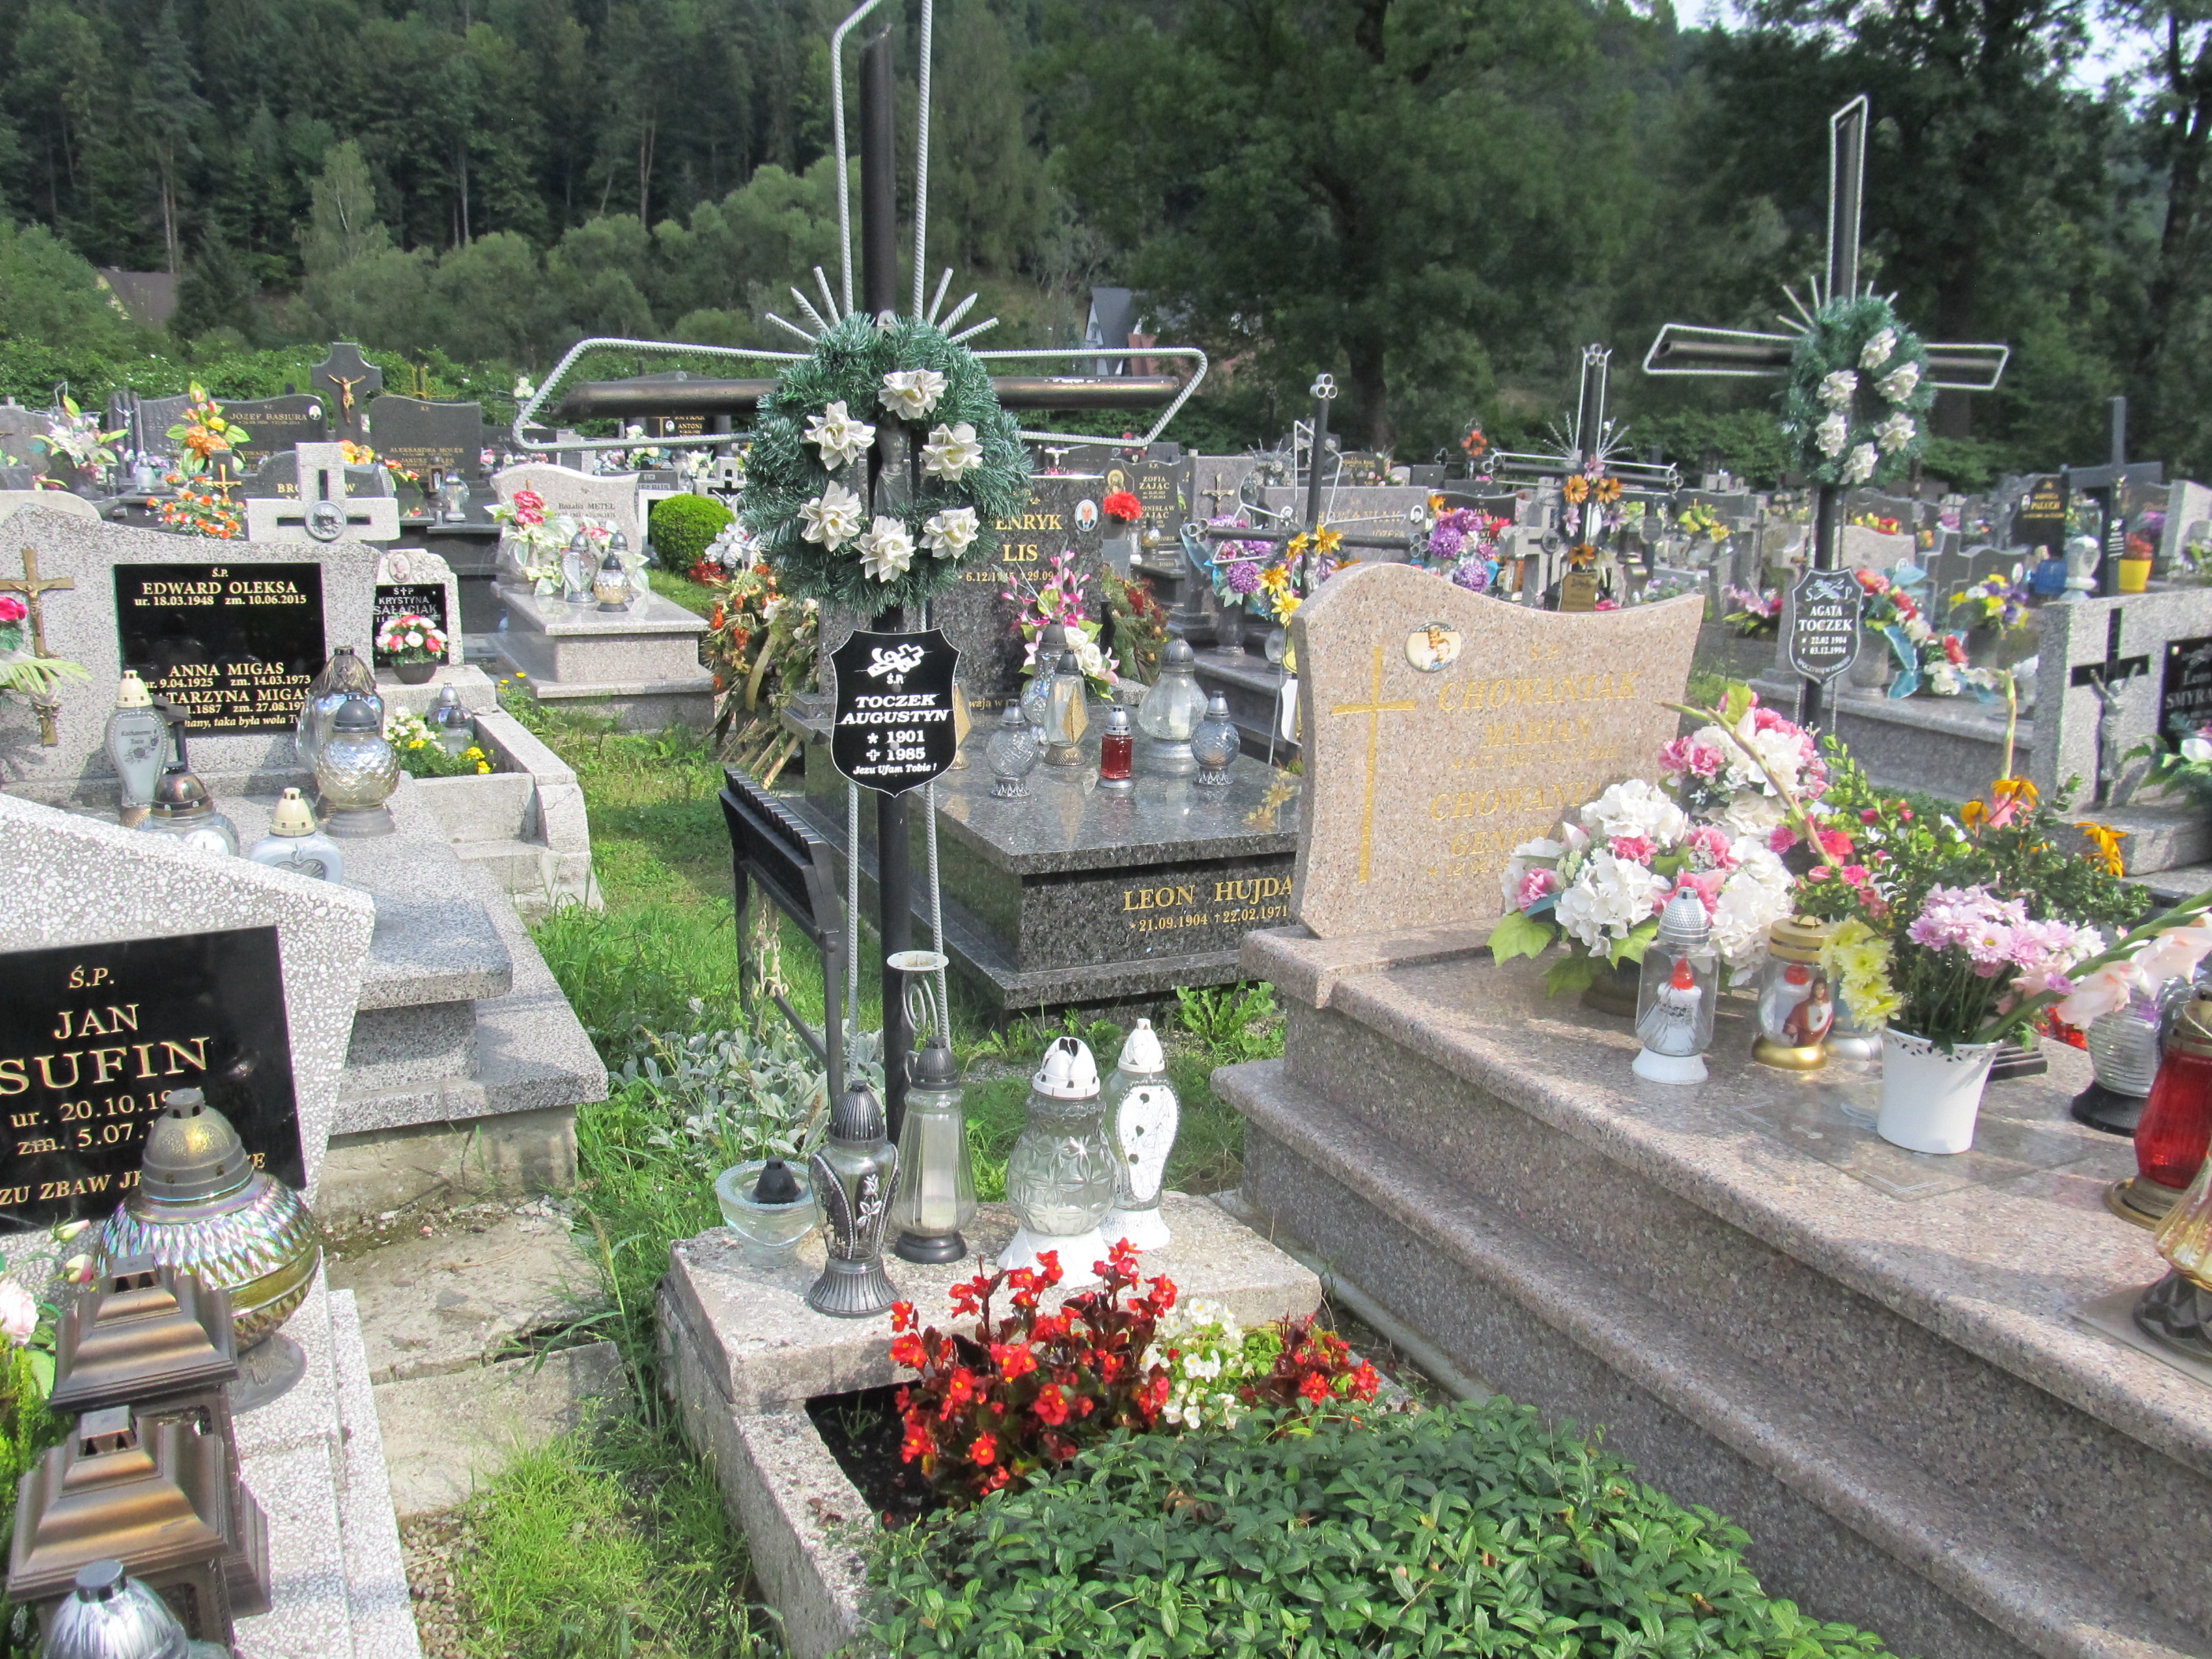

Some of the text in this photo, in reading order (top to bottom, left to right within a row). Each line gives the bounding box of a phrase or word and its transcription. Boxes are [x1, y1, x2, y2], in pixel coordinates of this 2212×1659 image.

[994, 514, 1063, 530] ENRYK
[1002, 544, 1038, 562] LIS
[142, 581, 298, 595] EDWARD OLEKSA
[134, 595, 307, 606] ur. 18.03.1948 zm. 10.06.2015
[379, 596, 430, 605] KRYSTYNA
[1810, 605, 1843, 616] AGATA
[1798, 619, 1853, 632] TOCZEK
[168, 662, 285, 677] ANNA MIGAS
[159, 678, 214, 688] 9.04.1925
[230, 677, 251, 687] zm.
[254, 676, 311, 686] 14.03.1973
[166, 691, 251, 704] TARZYNA
[1438, 672, 1640, 710] CHOWANIAK
[187, 705, 222, 714] 1.1887
[258, 701, 306, 712] 27.08.197
[855, 694, 939, 709] TOCZEK
[238, 716, 260, 726] była
[262, 715, 286, 724] wola
[840, 710, 949, 724] AUGUSTYN
[887, 731, 925, 743] 1901
[1481, 716, 1592, 748] MARIAN
[887, 748, 925, 760] 1985
[853, 766, 875, 775] Jezu
[877, 764, 903, 775] Ufam
[906, 763, 930, 773] Tobie
[1430, 780, 1599, 819] CHOWANI
[1452, 824, 1553, 857] GENOW
[1123, 876, 1293, 910] LEON HUJDA
[1139, 906, 1288, 931] 21.09.1904 22.02.1971
[68, 966, 115, 989] Ś.P.
[53, 1004, 140, 1040] JAN
[0, 1037, 210, 1095] SUFIN
[10, 1090, 172, 1128] ur. 20.10.19
[17, 1138, 66, 1155] zm.
[0, 1185, 31, 1205] ZU
[38, 1175, 112, 1199] ZBAW
